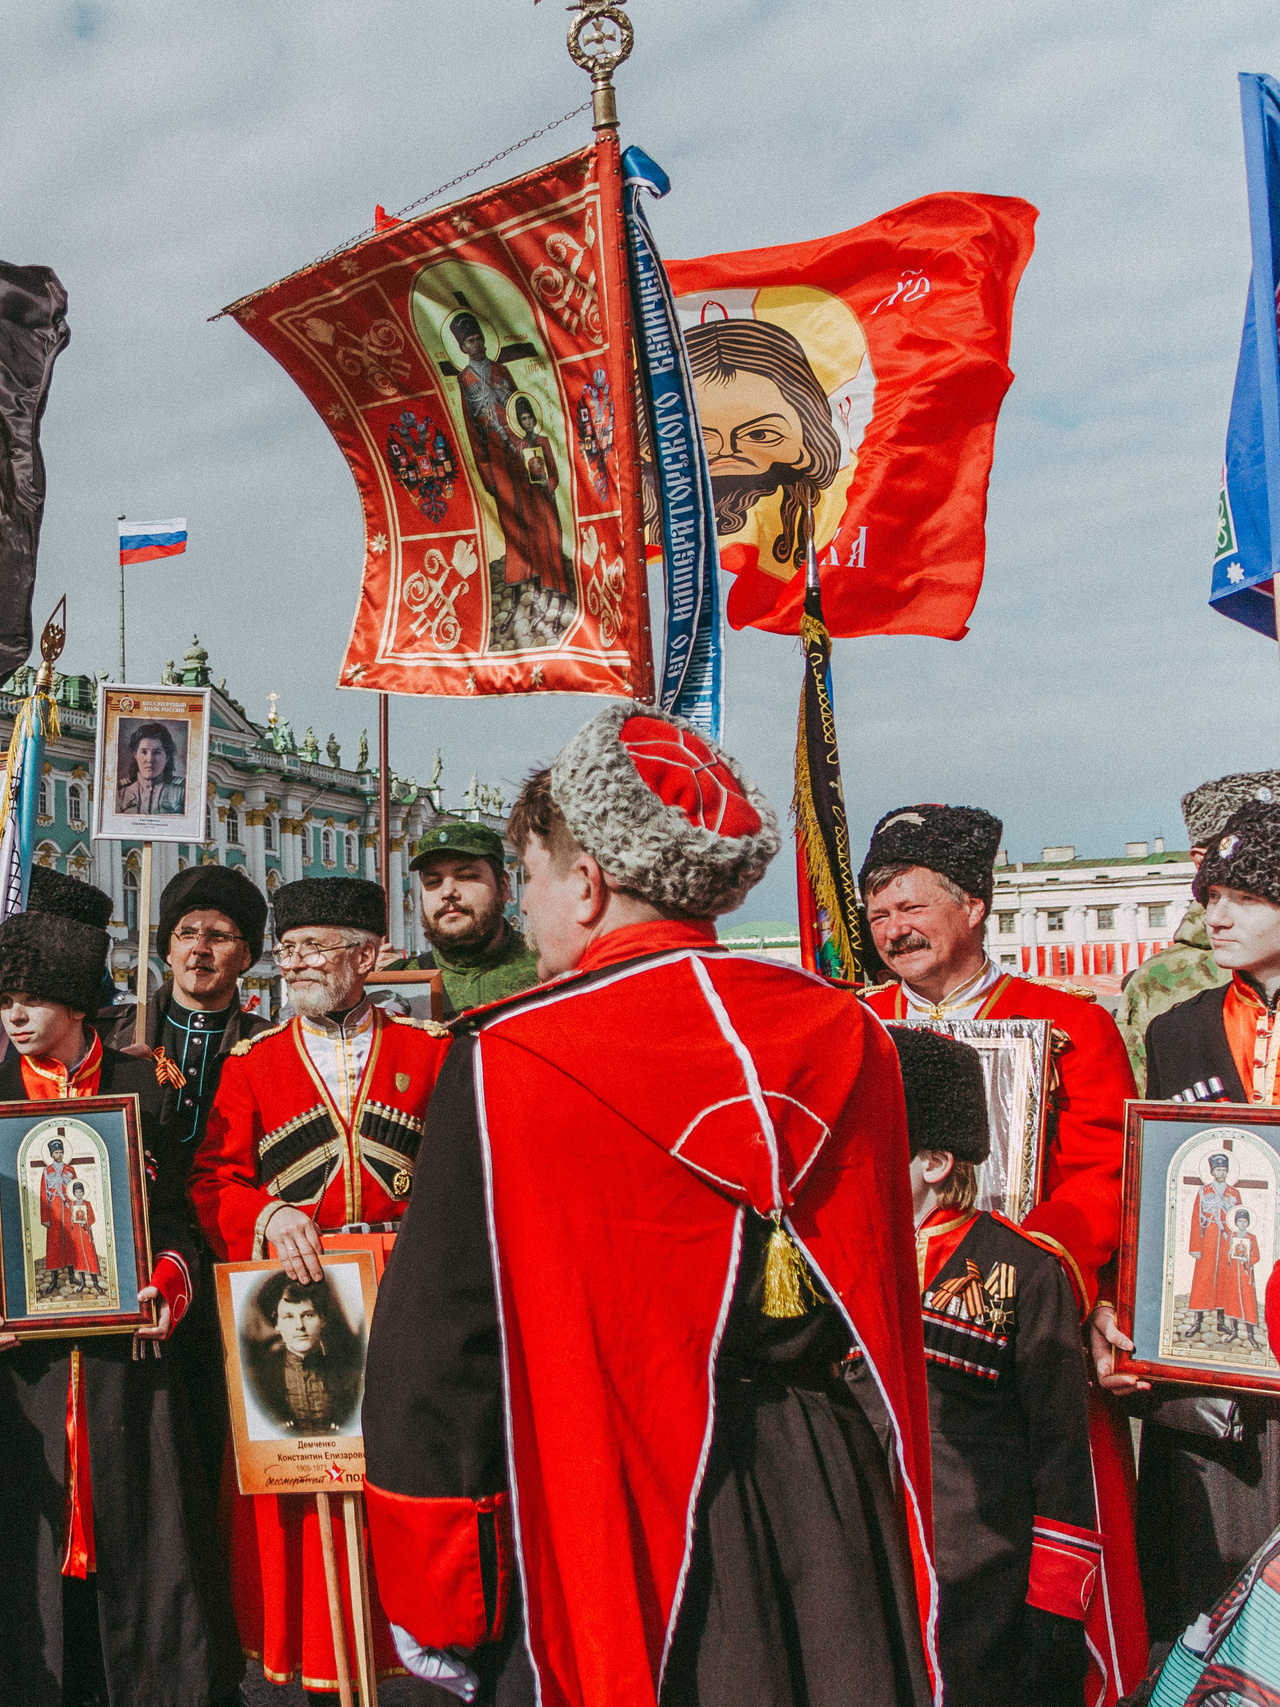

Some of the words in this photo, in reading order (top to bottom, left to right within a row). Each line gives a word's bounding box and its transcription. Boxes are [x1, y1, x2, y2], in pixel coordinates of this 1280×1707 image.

[653, 391, 696, 622] ИМПЕРАТОРСКОГО
[297, 1440, 337, 1450] Демченко
[277, 1453, 323, 1462] Константин
